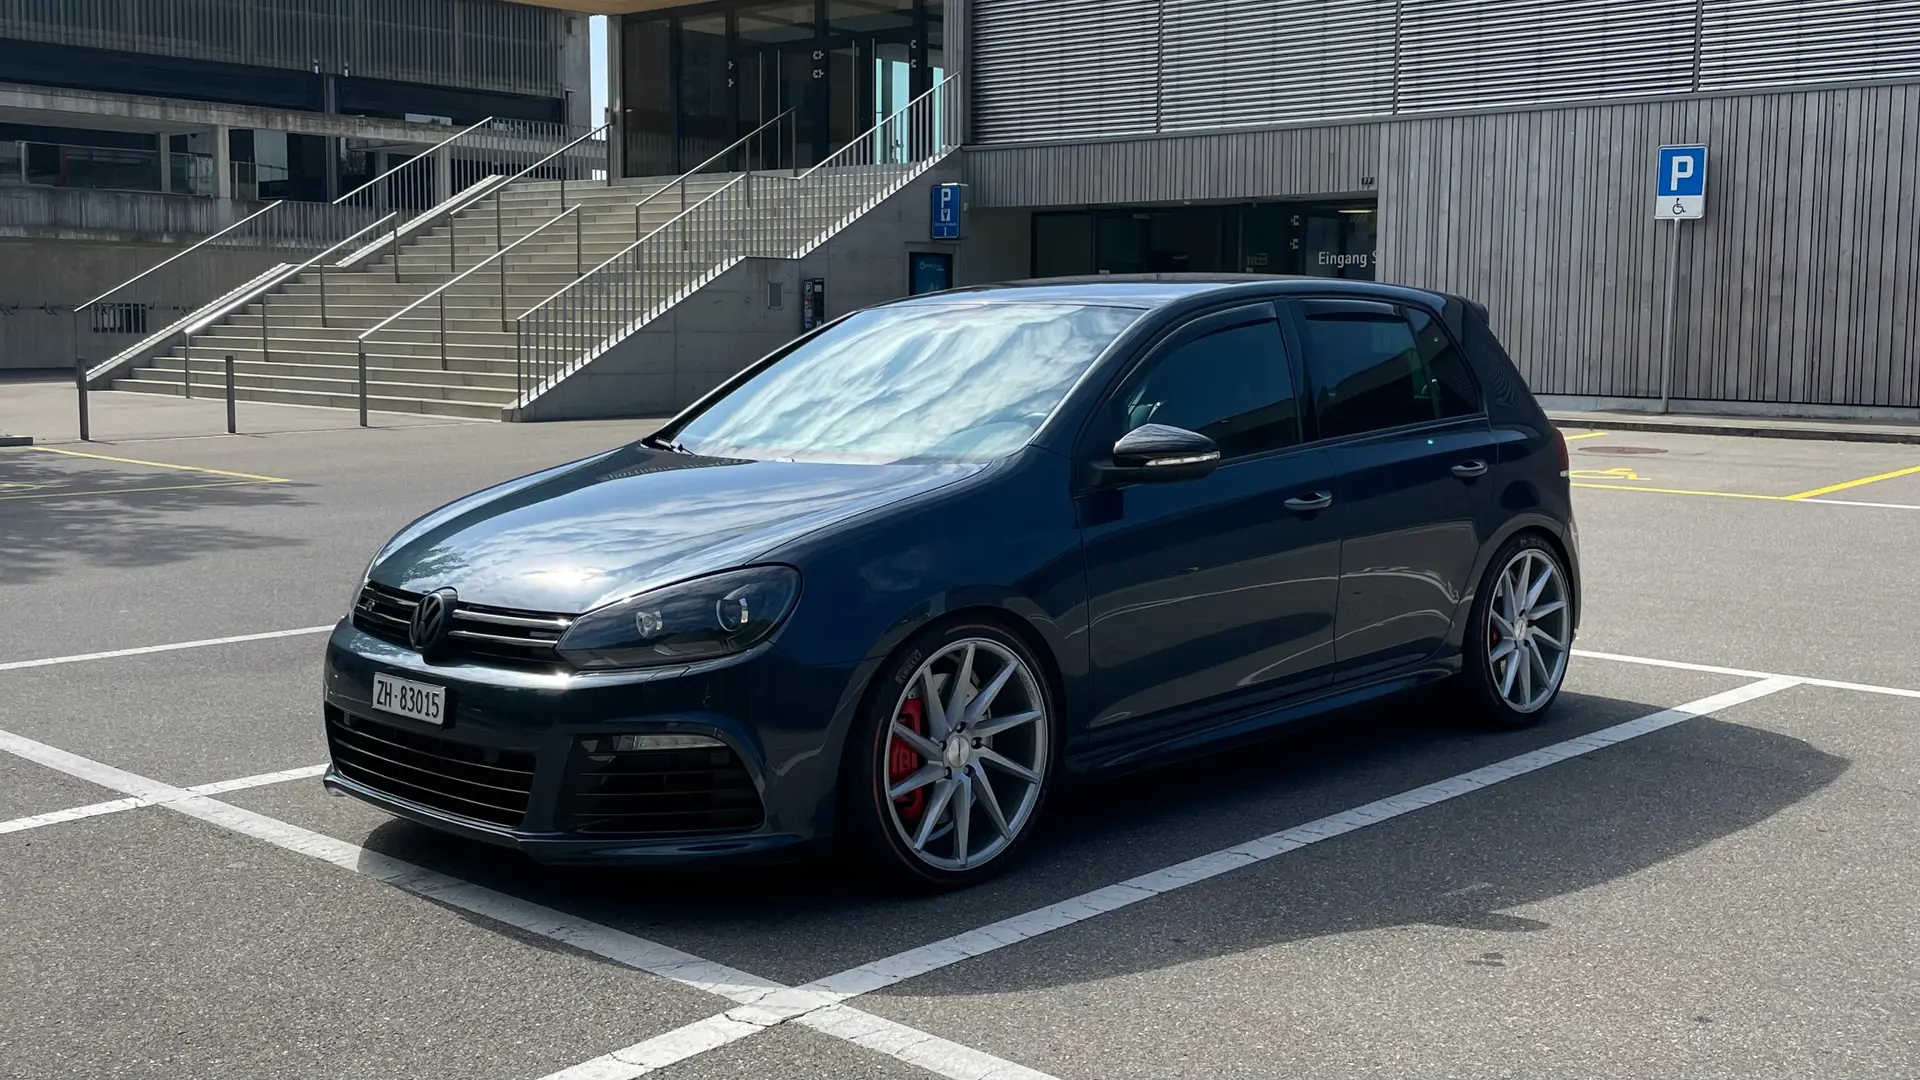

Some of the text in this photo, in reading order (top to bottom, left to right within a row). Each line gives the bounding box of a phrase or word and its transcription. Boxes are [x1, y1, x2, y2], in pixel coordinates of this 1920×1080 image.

[1670, 155, 1694, 191] P
[941, 188, 951, 208] P
[1318, 251, 1367, 268] Eingang
